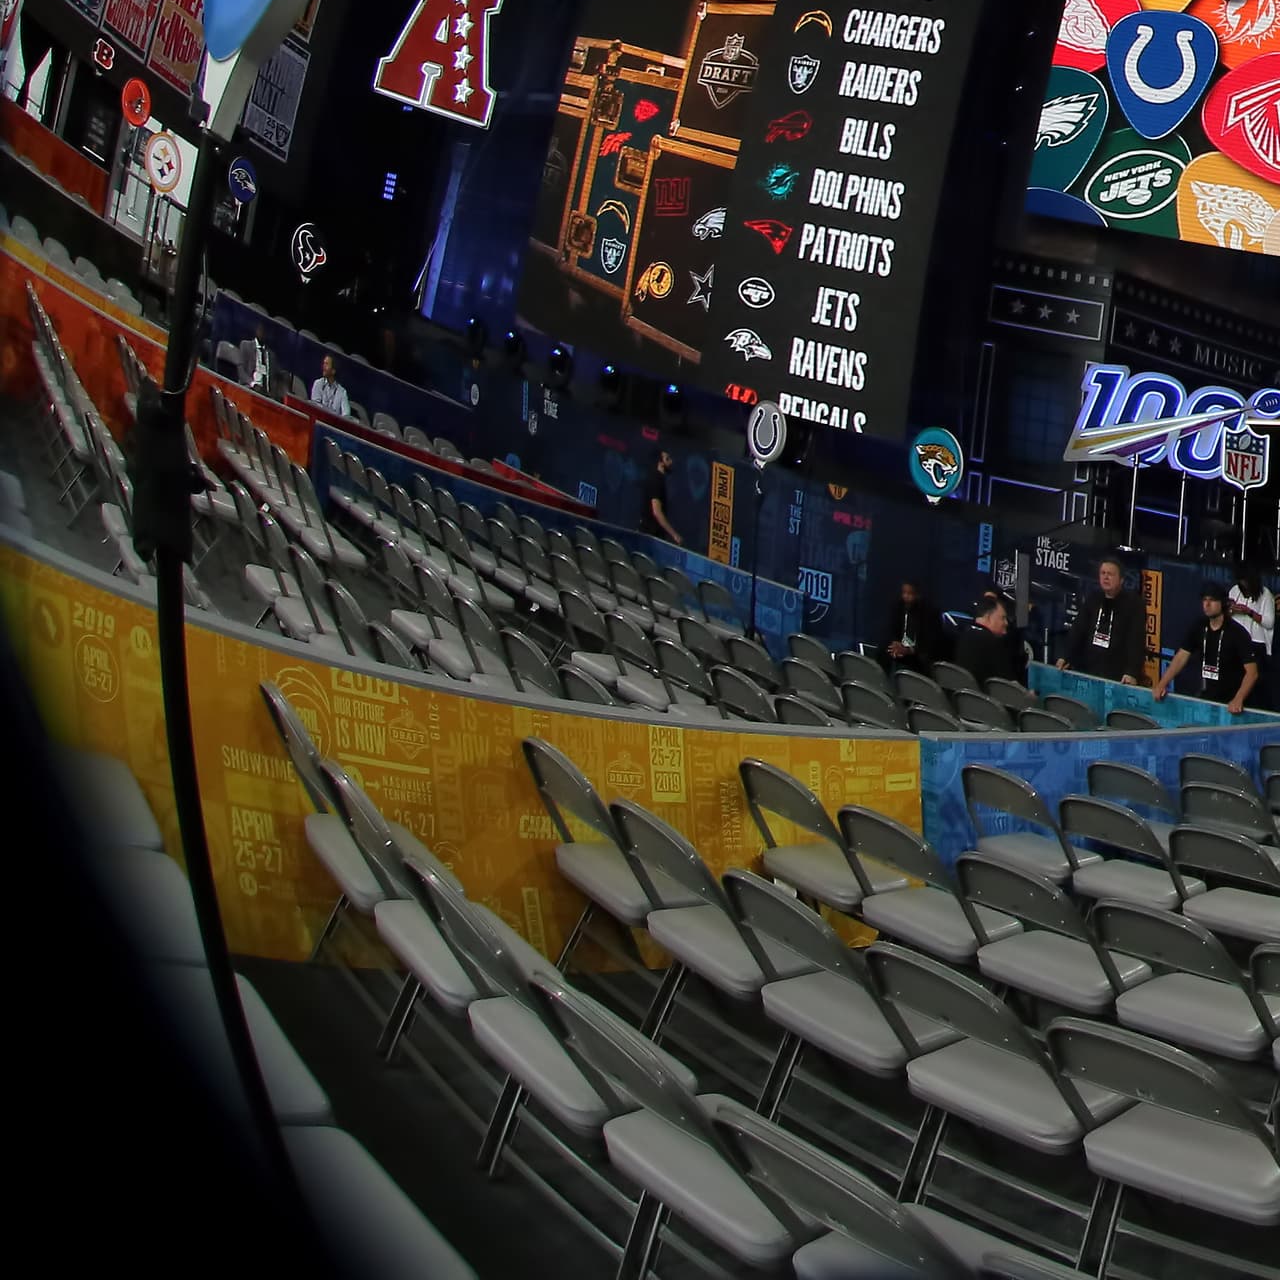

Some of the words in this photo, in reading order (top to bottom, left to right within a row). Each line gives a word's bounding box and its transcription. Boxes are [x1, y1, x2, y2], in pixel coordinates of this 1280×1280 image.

[843, 8, 946, 55] CHARGERS
[703, 64, 752, 84] DRAFT
[838, 60, 923, 107] RAIDERS
[838, 117, 897, 161] BILLS
[1099, 166, 1173, 206] JETS
[1103, 169, 1130, 183] NEW
[1131, 159, 1163, 177] YORK
[808, 167, 905, 220] DOLPHINS
[797, 222, 896, 278] PATRIOTS
[810, 285, 861, 332] JETS
[787, 336, 869, 392] RAVENS
[1191, 342, 1265, 381] MUSIC
[718, 466, 731, 500] APRIL
[1226, 451, 1263, 483] NFL
[1037, 535, 1052, 549] THE
[1036, 548, 1071, 572] STAGE
[73, 601, 116, 639] 2019
[83, 644, 112, 675] APRIL
[84, 667, 113, 693] 25-27
[334, 694, 351, 715] OUR
[352, 698, 386, 724] FUTURE
[428, 703, 441, 741] 2019
[335, 718, 350, 748] IS
[354, 723, 387, 756] NOW
[391, 728, 426, 744] DRAFT
[454, 731, 490, 767] NOW
[651, 728, 681, 748] APRIL
[221, 744, 295, 784] SHOWTIME
[651, 748, 682, 767] 25-27
[381, 775, 432, 794] NASHVILLE
[608, 772, 643, 786] DRAFT
[656, 773, 681, 793] 2019
[383, 788, 433, 807] TENNESSEE
[730, 780, 743, 850] NASHVILLE
[231, 806, 280, 844] APRIL
[719, 780, 733, 851] TENNESSEE
[233, 840, 283, 874] 25-27
